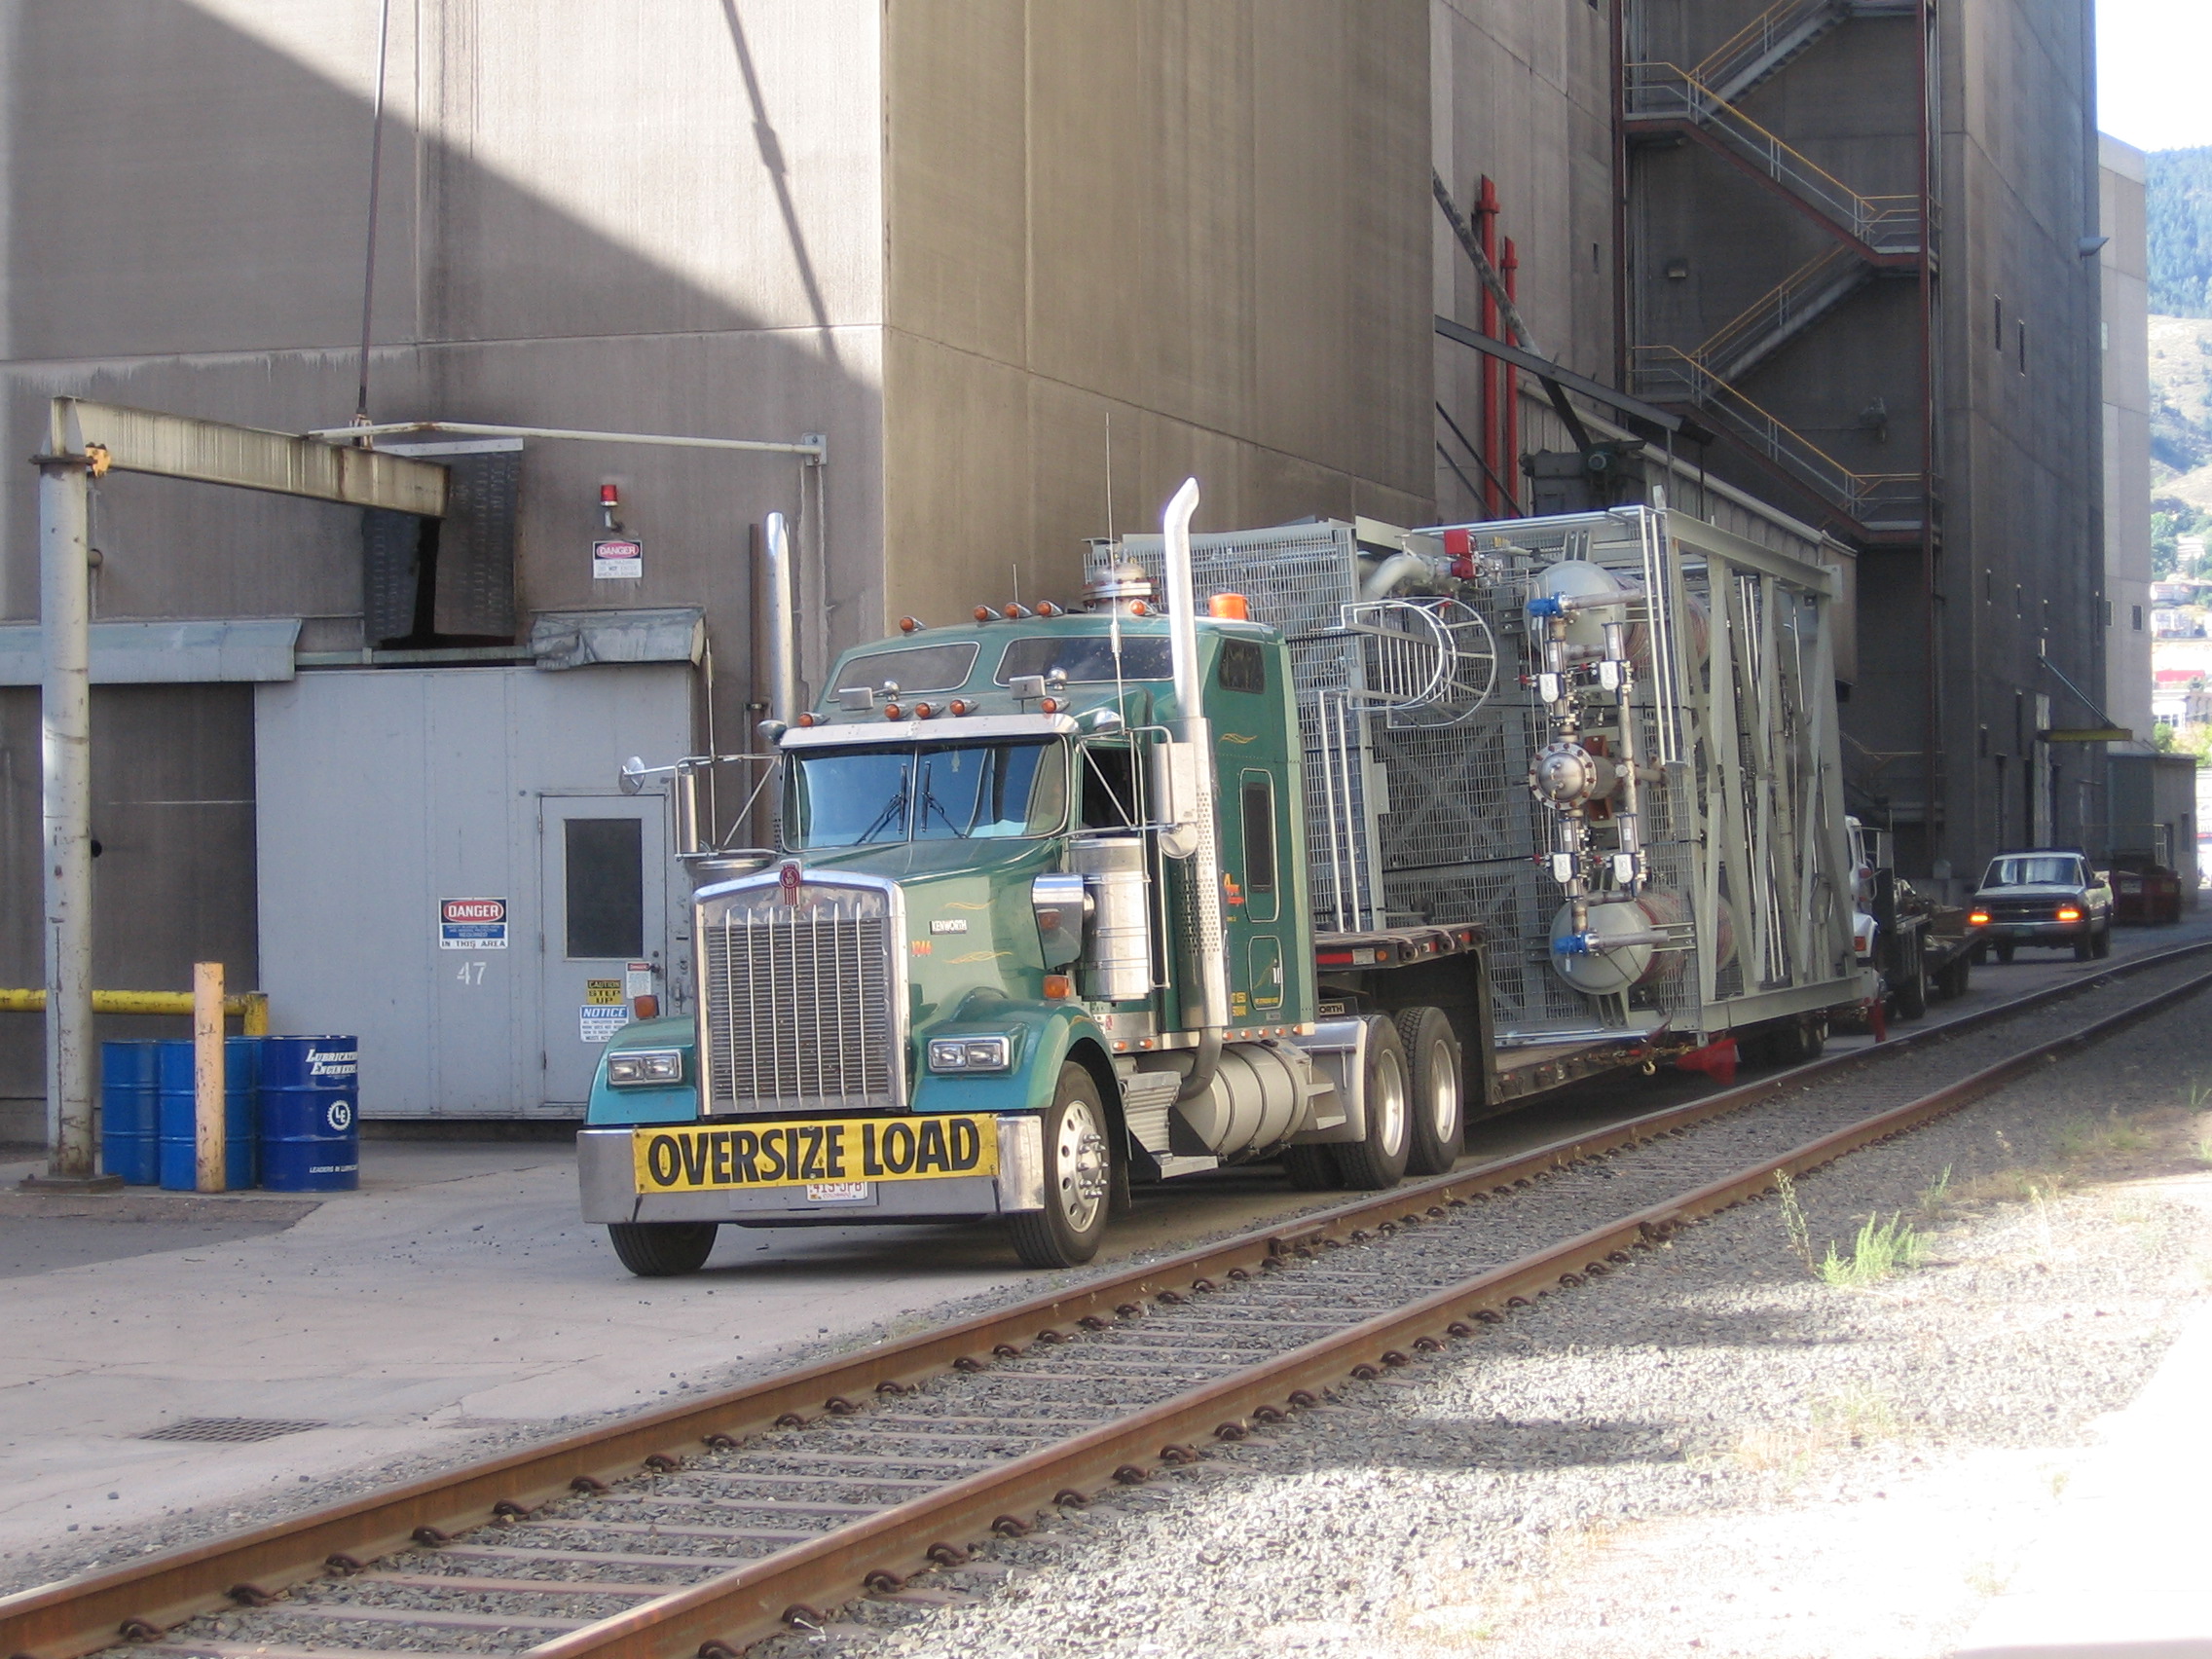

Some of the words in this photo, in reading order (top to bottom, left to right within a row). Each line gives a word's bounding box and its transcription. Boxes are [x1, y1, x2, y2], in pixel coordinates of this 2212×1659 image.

[599, 546, 636, 555] DANGER
[448, 904, 499, 918] DANGER
[932, 920, 967, 932] KENWORTH
[457, 961, 487, 985] 47
[583, 1007, 626, 1017] NOTICE
[335, 1106, 346, 1124] LE
[647, 1124, 845, 1187] OVERSIZE
[863, 1118, 980, 1176] LOAD
